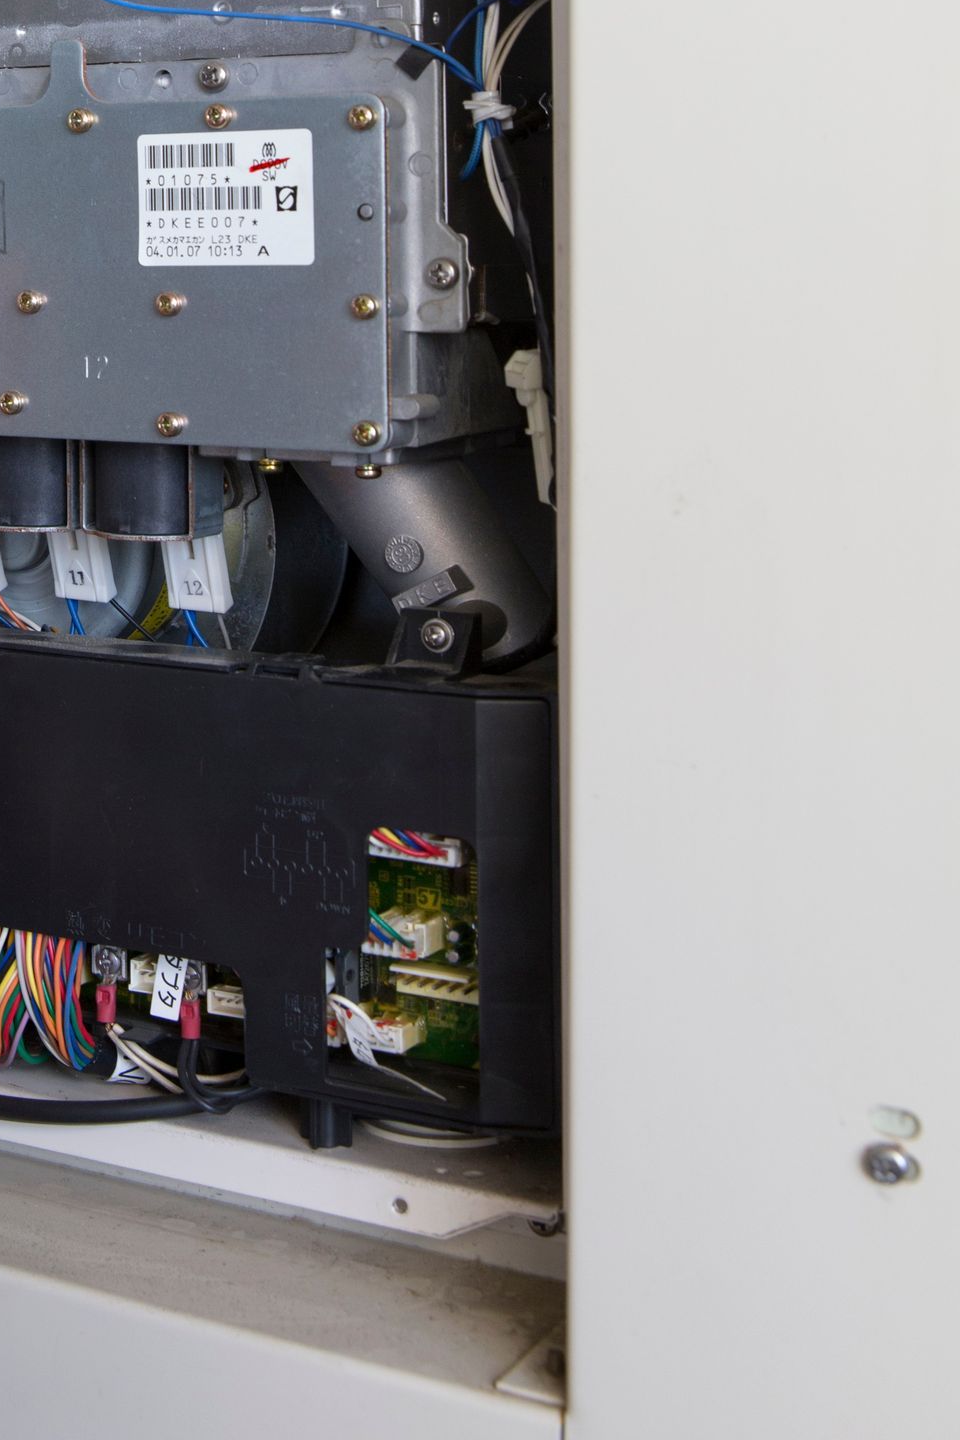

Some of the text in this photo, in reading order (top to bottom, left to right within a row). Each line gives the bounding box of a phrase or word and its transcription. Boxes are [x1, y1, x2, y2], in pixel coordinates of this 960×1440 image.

[262, 170, 277, 182] SW
[211, 235, 231, 244] L23
[238, 234, 258, 244] DKE
[146, 245, 270, 257] 04.01.07 10:13 A
[68, 569, 85, 586] 11
[183, 579, 204, 597] 12
